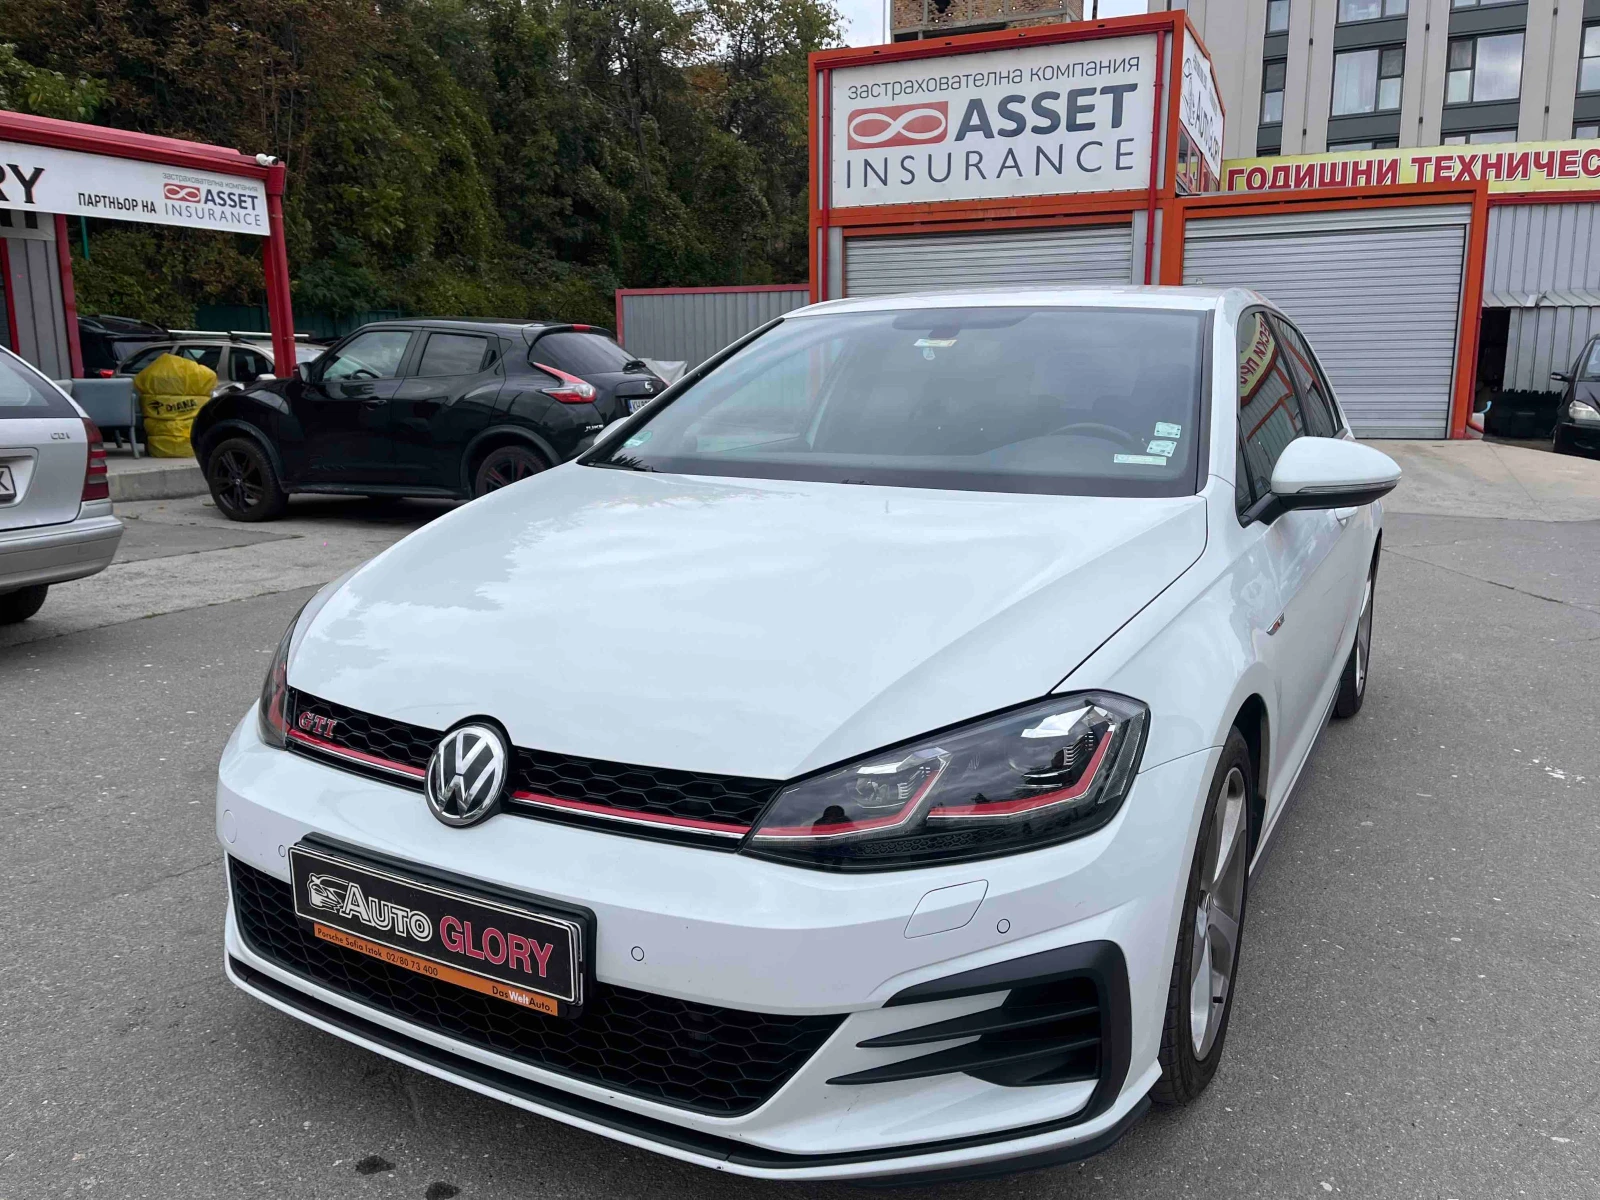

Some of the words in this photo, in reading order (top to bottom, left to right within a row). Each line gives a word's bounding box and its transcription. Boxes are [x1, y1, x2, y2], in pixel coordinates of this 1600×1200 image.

[847, 68, 1023, 101] застрахователна
[1030, 56, 1140, 83] компания
[954, 83, 1138, 142] ASSET
[846, 137, 1135, 189] INSURANCE
[1228, 157, 1400, 191] ГОДИШНИ
[162, 172, 224, 188] застрахователна
[225, 182, 258, 193] компания
[77, 192, 139, 212] ПАРТНЬОР
[141, 199, 157, 214] НА
[164, 202, 261, 227] INSURANCE
[204, 189, 258, 211] ASSET
[299, 711, 338, 739] GTI
[317, 927, 344, 944] Porsche
[345, 938, 364, 952] Sofia
[386, 951, 409, 967] 02/80
[410, 960, 421, 971] 73
[422, 964, 438, 977] 400
[439, 915, 553, 978] GLORY
